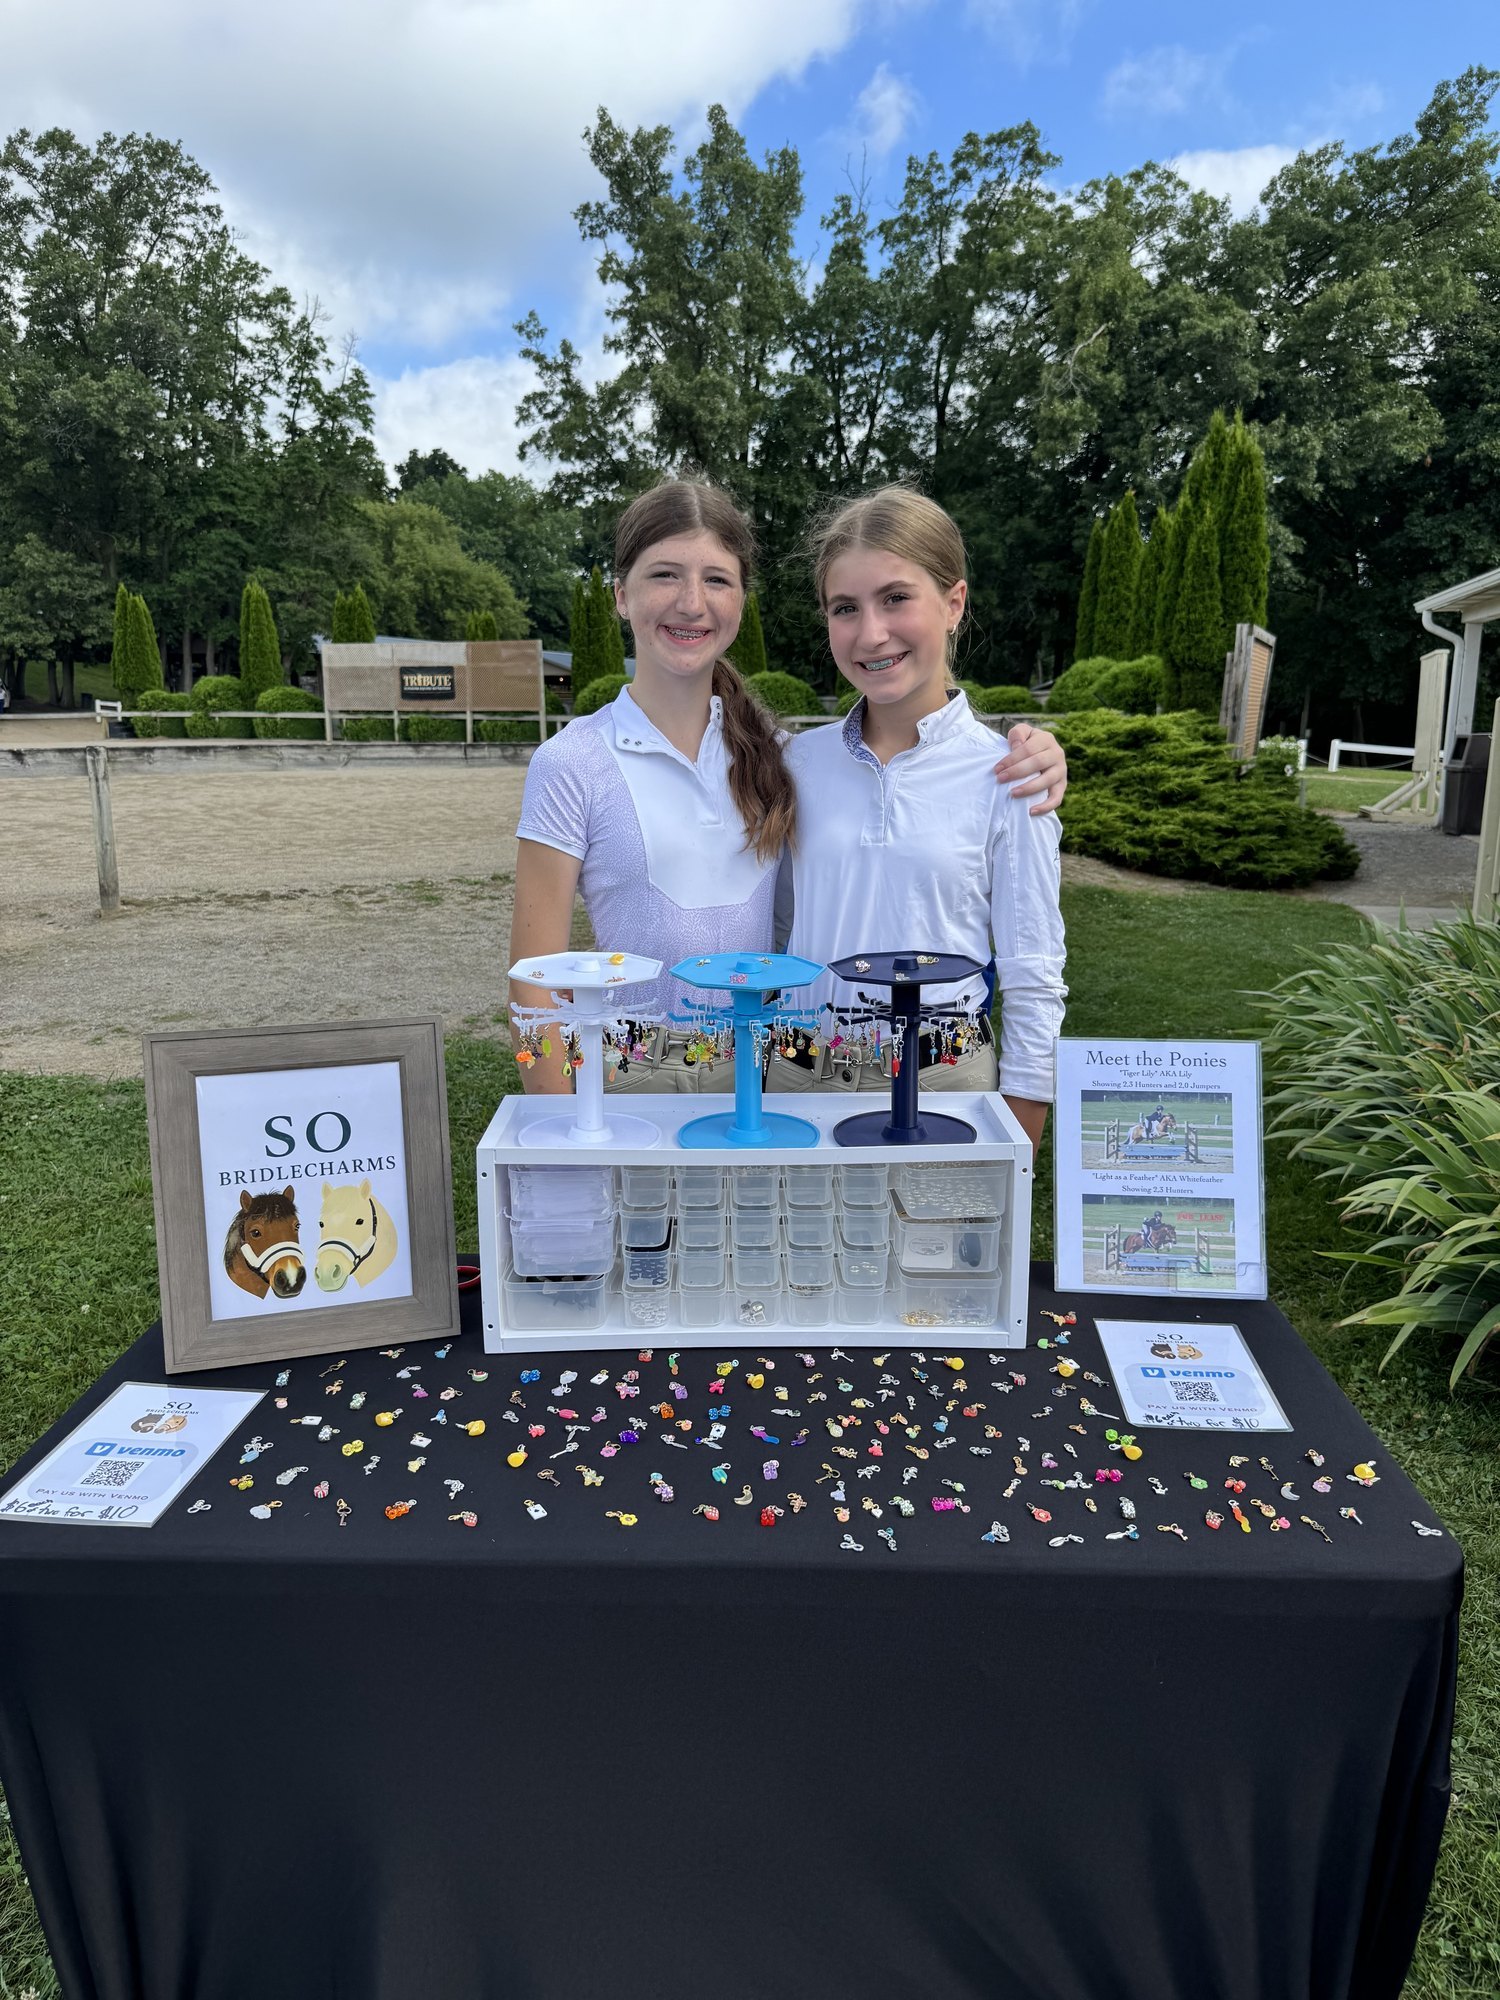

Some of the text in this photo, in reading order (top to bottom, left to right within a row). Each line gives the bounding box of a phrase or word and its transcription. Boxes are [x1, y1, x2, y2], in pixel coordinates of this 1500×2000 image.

[403, 674, 452, 686] TRIBUTE
[1085, 1050, 1227, 1068] Meet the Ponies
[1120, 1070, 1140, 1078] "Tiger
[1142, 1070, 1158, 1078] Lily"
[1179, 1071, 1192, 1079] Lily
[1092, 1081, 1121, 1089] Showing
[264, 1111, 352, 1158] SO
[218, 1155, 397, 1187] BRIDLECHARMS
[1092, 1172, 1113, 1181] "Light
[1179, 1175, 1224, 1183] Whitefeather
[1122, 1185, 1151, 1194] Showing
[1157, 1333, 1183, 1341] SO
[1169, 1370, 1235, 1378] venmo
[163, 1401, 192, 1410] SO
[1205, 1418, 1226, 1428] for
[1231, 1416, 1260, 1429] $10
[117, 1446, 186, 1457] venmo
[64, 1506, 94, 1518] for
[98, 1505, 139, 1519] $10
